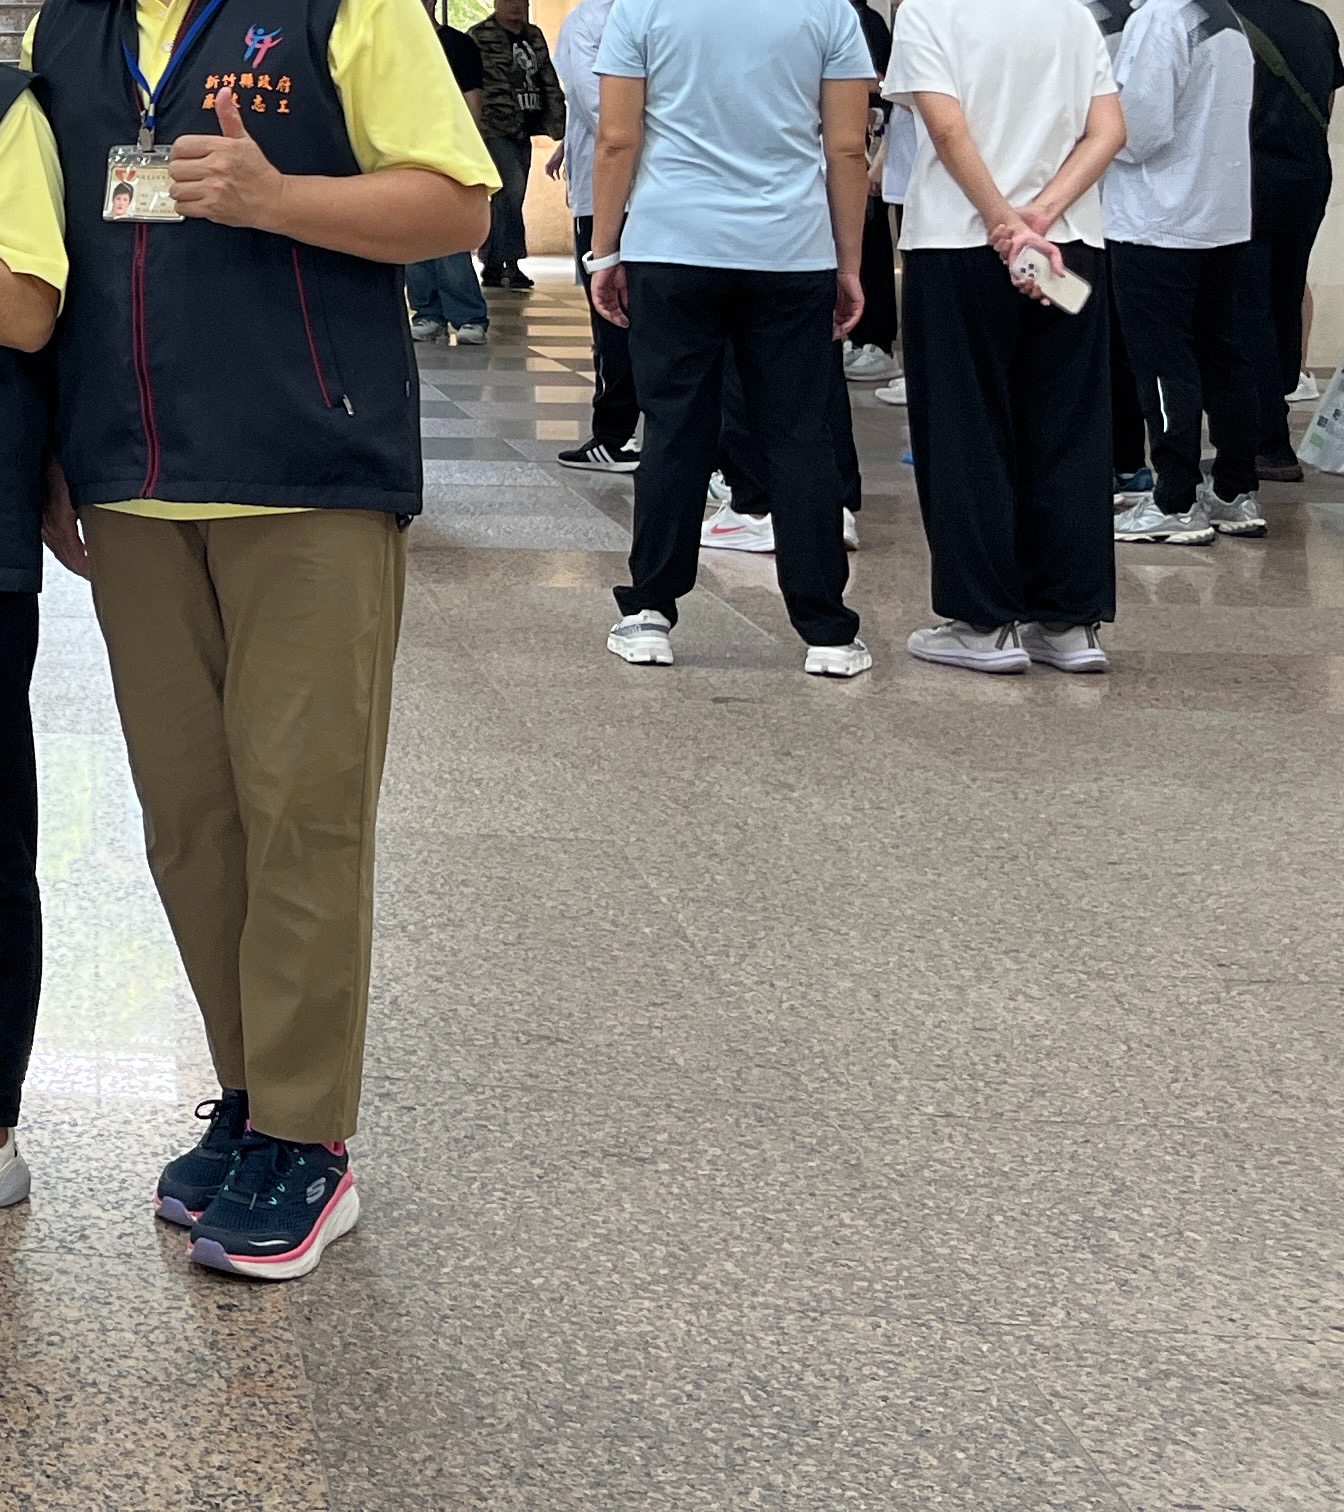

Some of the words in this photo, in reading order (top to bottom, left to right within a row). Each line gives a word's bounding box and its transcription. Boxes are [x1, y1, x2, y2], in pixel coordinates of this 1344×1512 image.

[204, 72, 292, 94] 新竹縣政府
